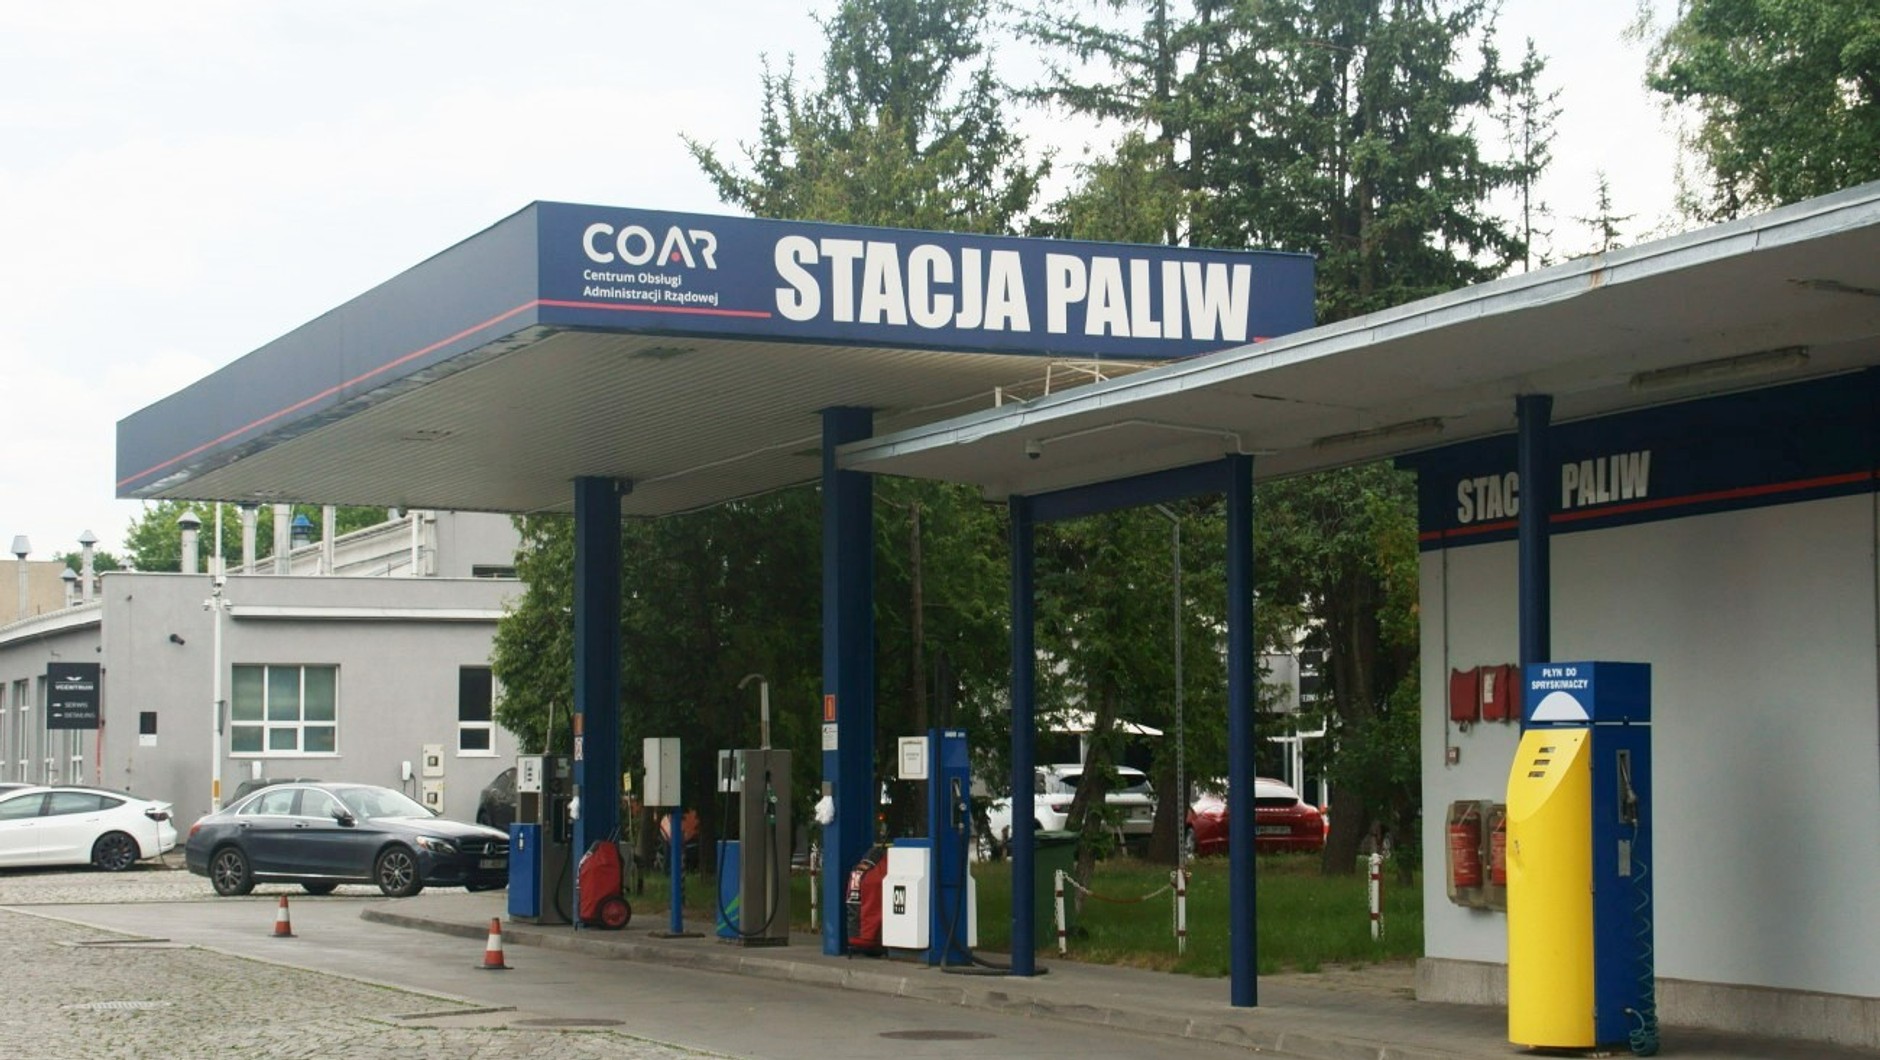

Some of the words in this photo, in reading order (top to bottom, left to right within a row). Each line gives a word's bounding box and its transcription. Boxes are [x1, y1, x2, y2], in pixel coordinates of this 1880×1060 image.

[583, 222, 718, 271] COAR
[583, 269, 635, 284] Centrum
[638, 272, 682, 288] Obsługi
[774, 234, 1032, 333] STACJA
[1045, 252, 1252, 342] PALIW
[583, 286, 661, 303] Administracji
[664, 290, 719, 306] Rządowej
[1457, 471, 1519, 523] STAC
[1562, 449, 1651, 508] PALIW
[1565, 667, 1577, 677] DO
